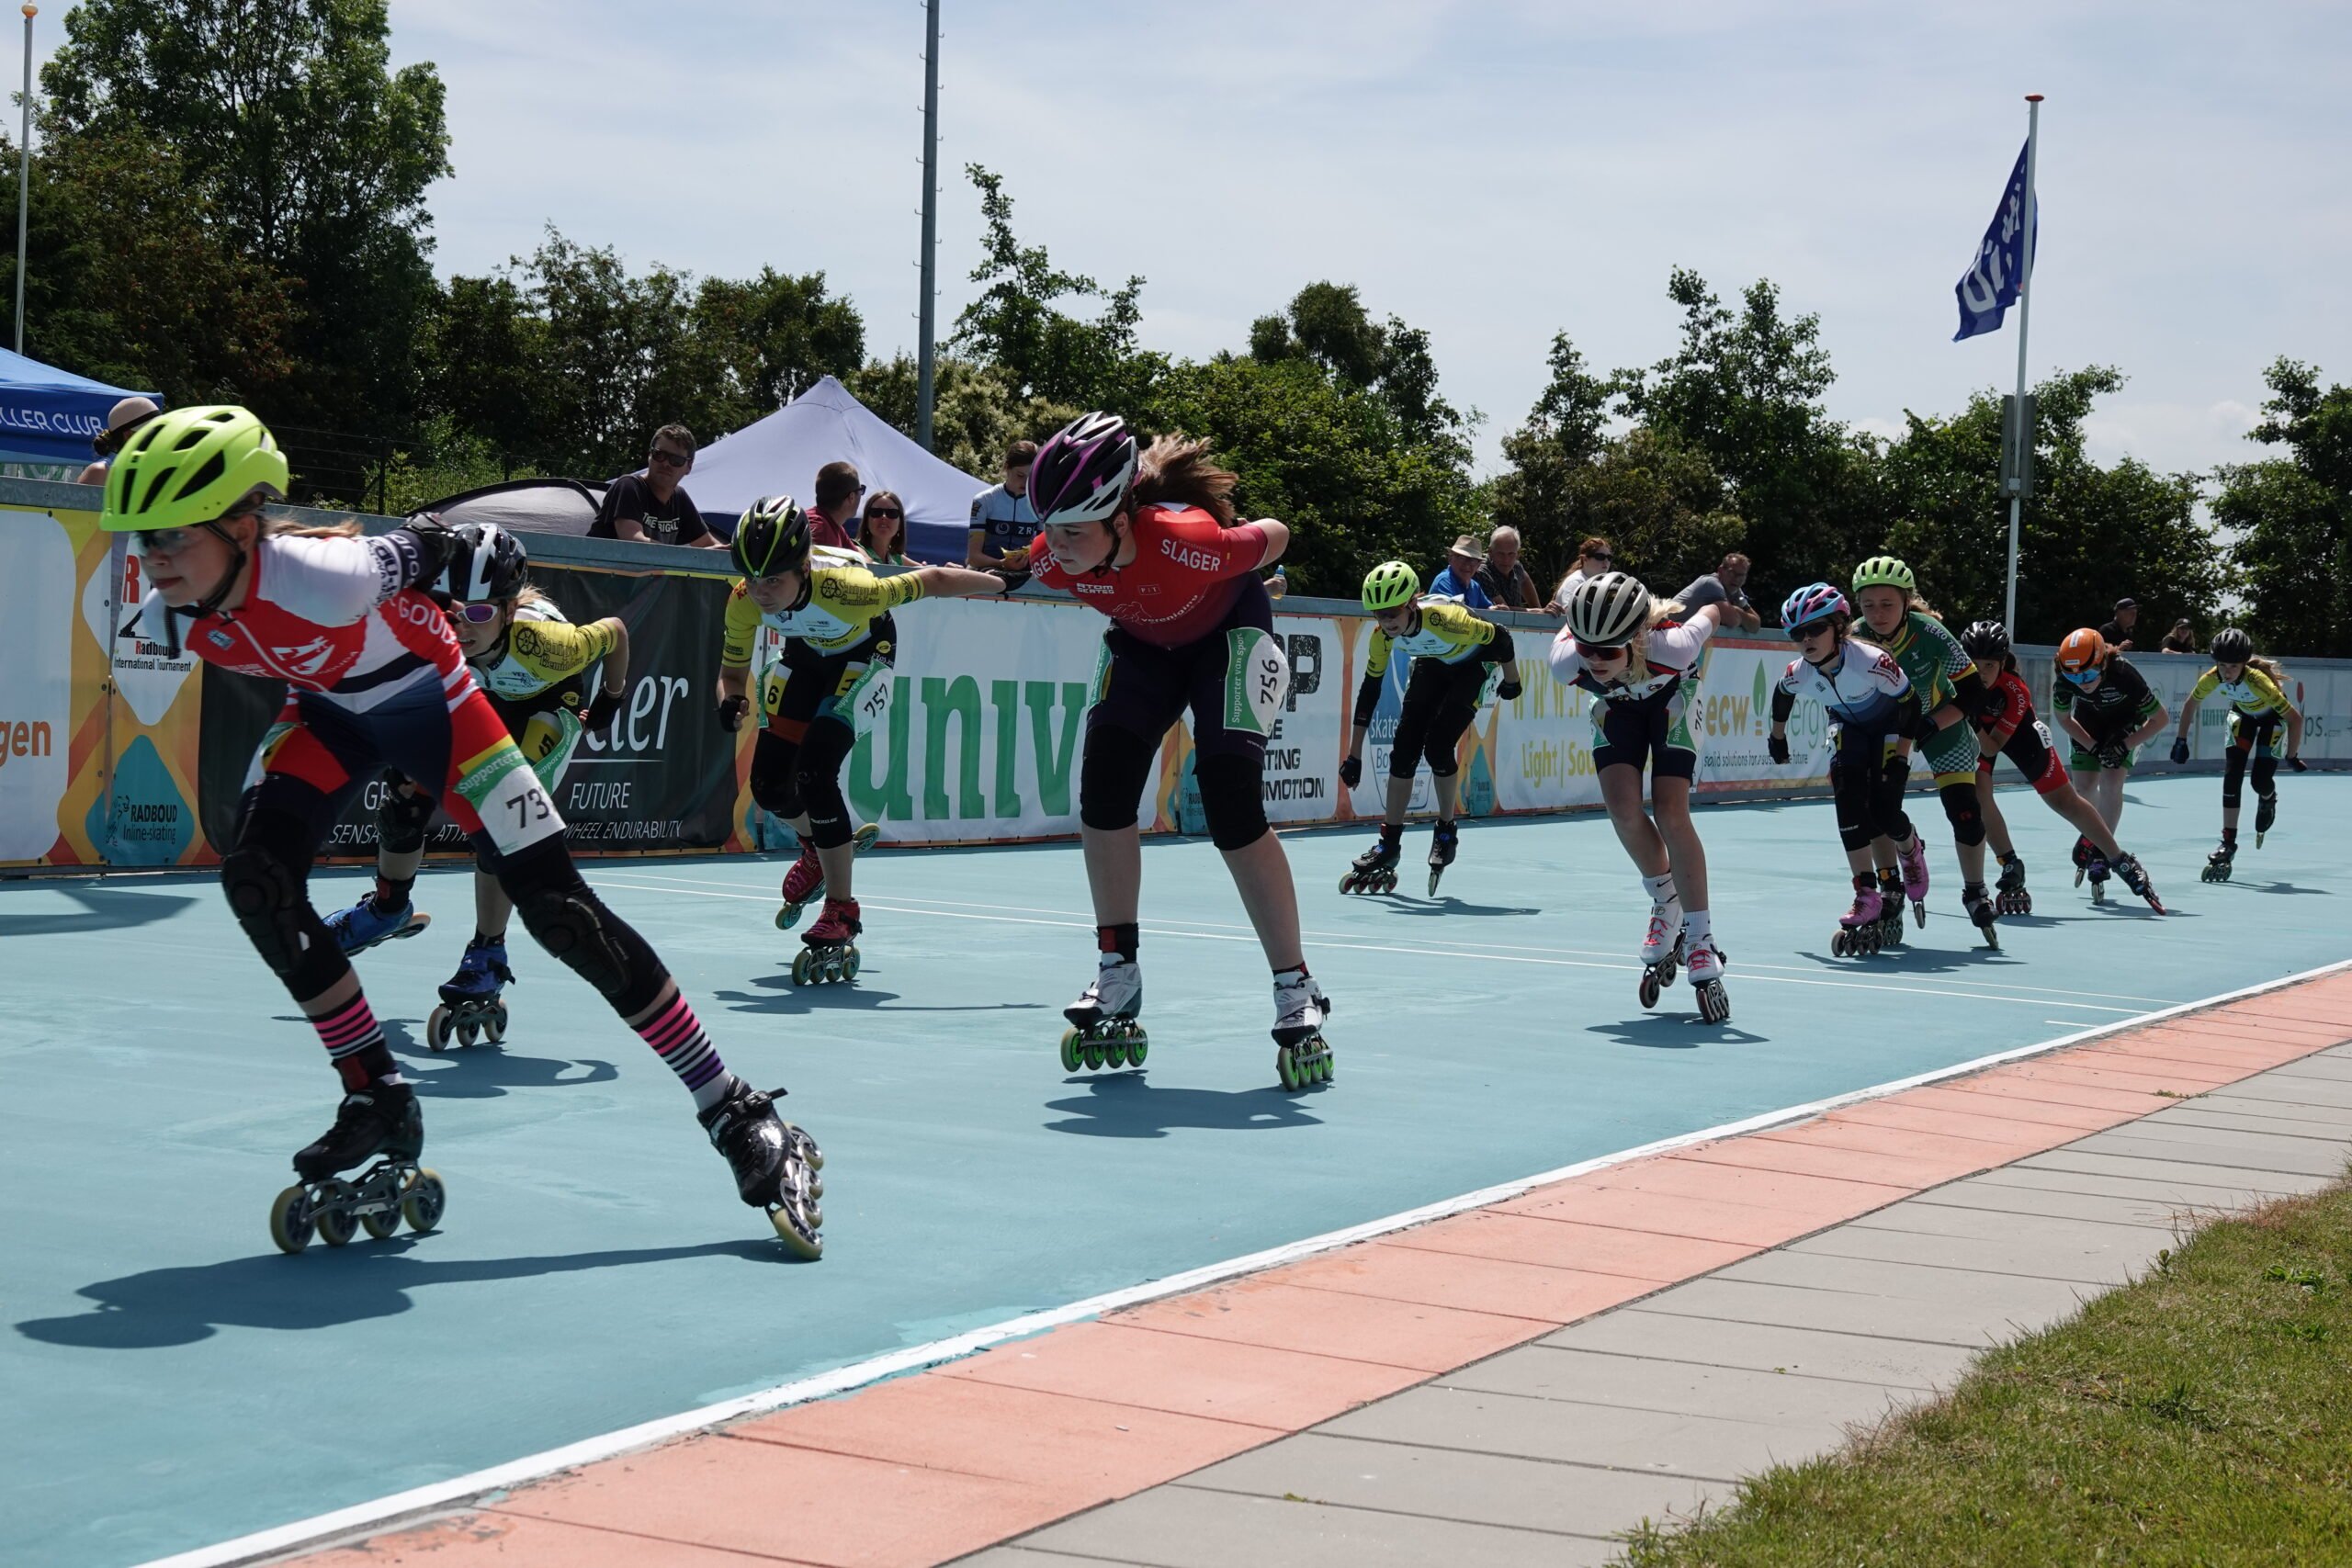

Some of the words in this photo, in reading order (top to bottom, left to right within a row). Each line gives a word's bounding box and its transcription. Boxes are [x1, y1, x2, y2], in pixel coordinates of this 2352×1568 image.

[0, 407, 52, 431] LLER
[52, 412, 103, 435] CLUB
[1161, 539, 1220, 571] SLAGER
[1924, 624, 1947, 640] REKO
[136, 641, 172, 657] Radbou
[114, 659, 155, 671] International
[157, 659, 191, 672] Tournament
[1234, 657, 1242, 675] van
[1261, 659, 1279, 705] 756
[767, 685, 780, 705] 6
[864, 683, 888, 718] 757
[1232, 676, 1242, 723] Supporter
[1705, 695, 1750, 737] ecw
[1522, 739, 1557, 788] Light
[570, 783, 631, 809] FUTURE
[130, 804, 177, 823] RADBOUD
[505, 787, 550, 829] 73
[123, 824, 176, 844] Inline-skating
[329, 824, 379, 844] SENSA
[563, 822, 602, 840] WHEEL
[603, 820, 683, 840] ENDURABILITY
